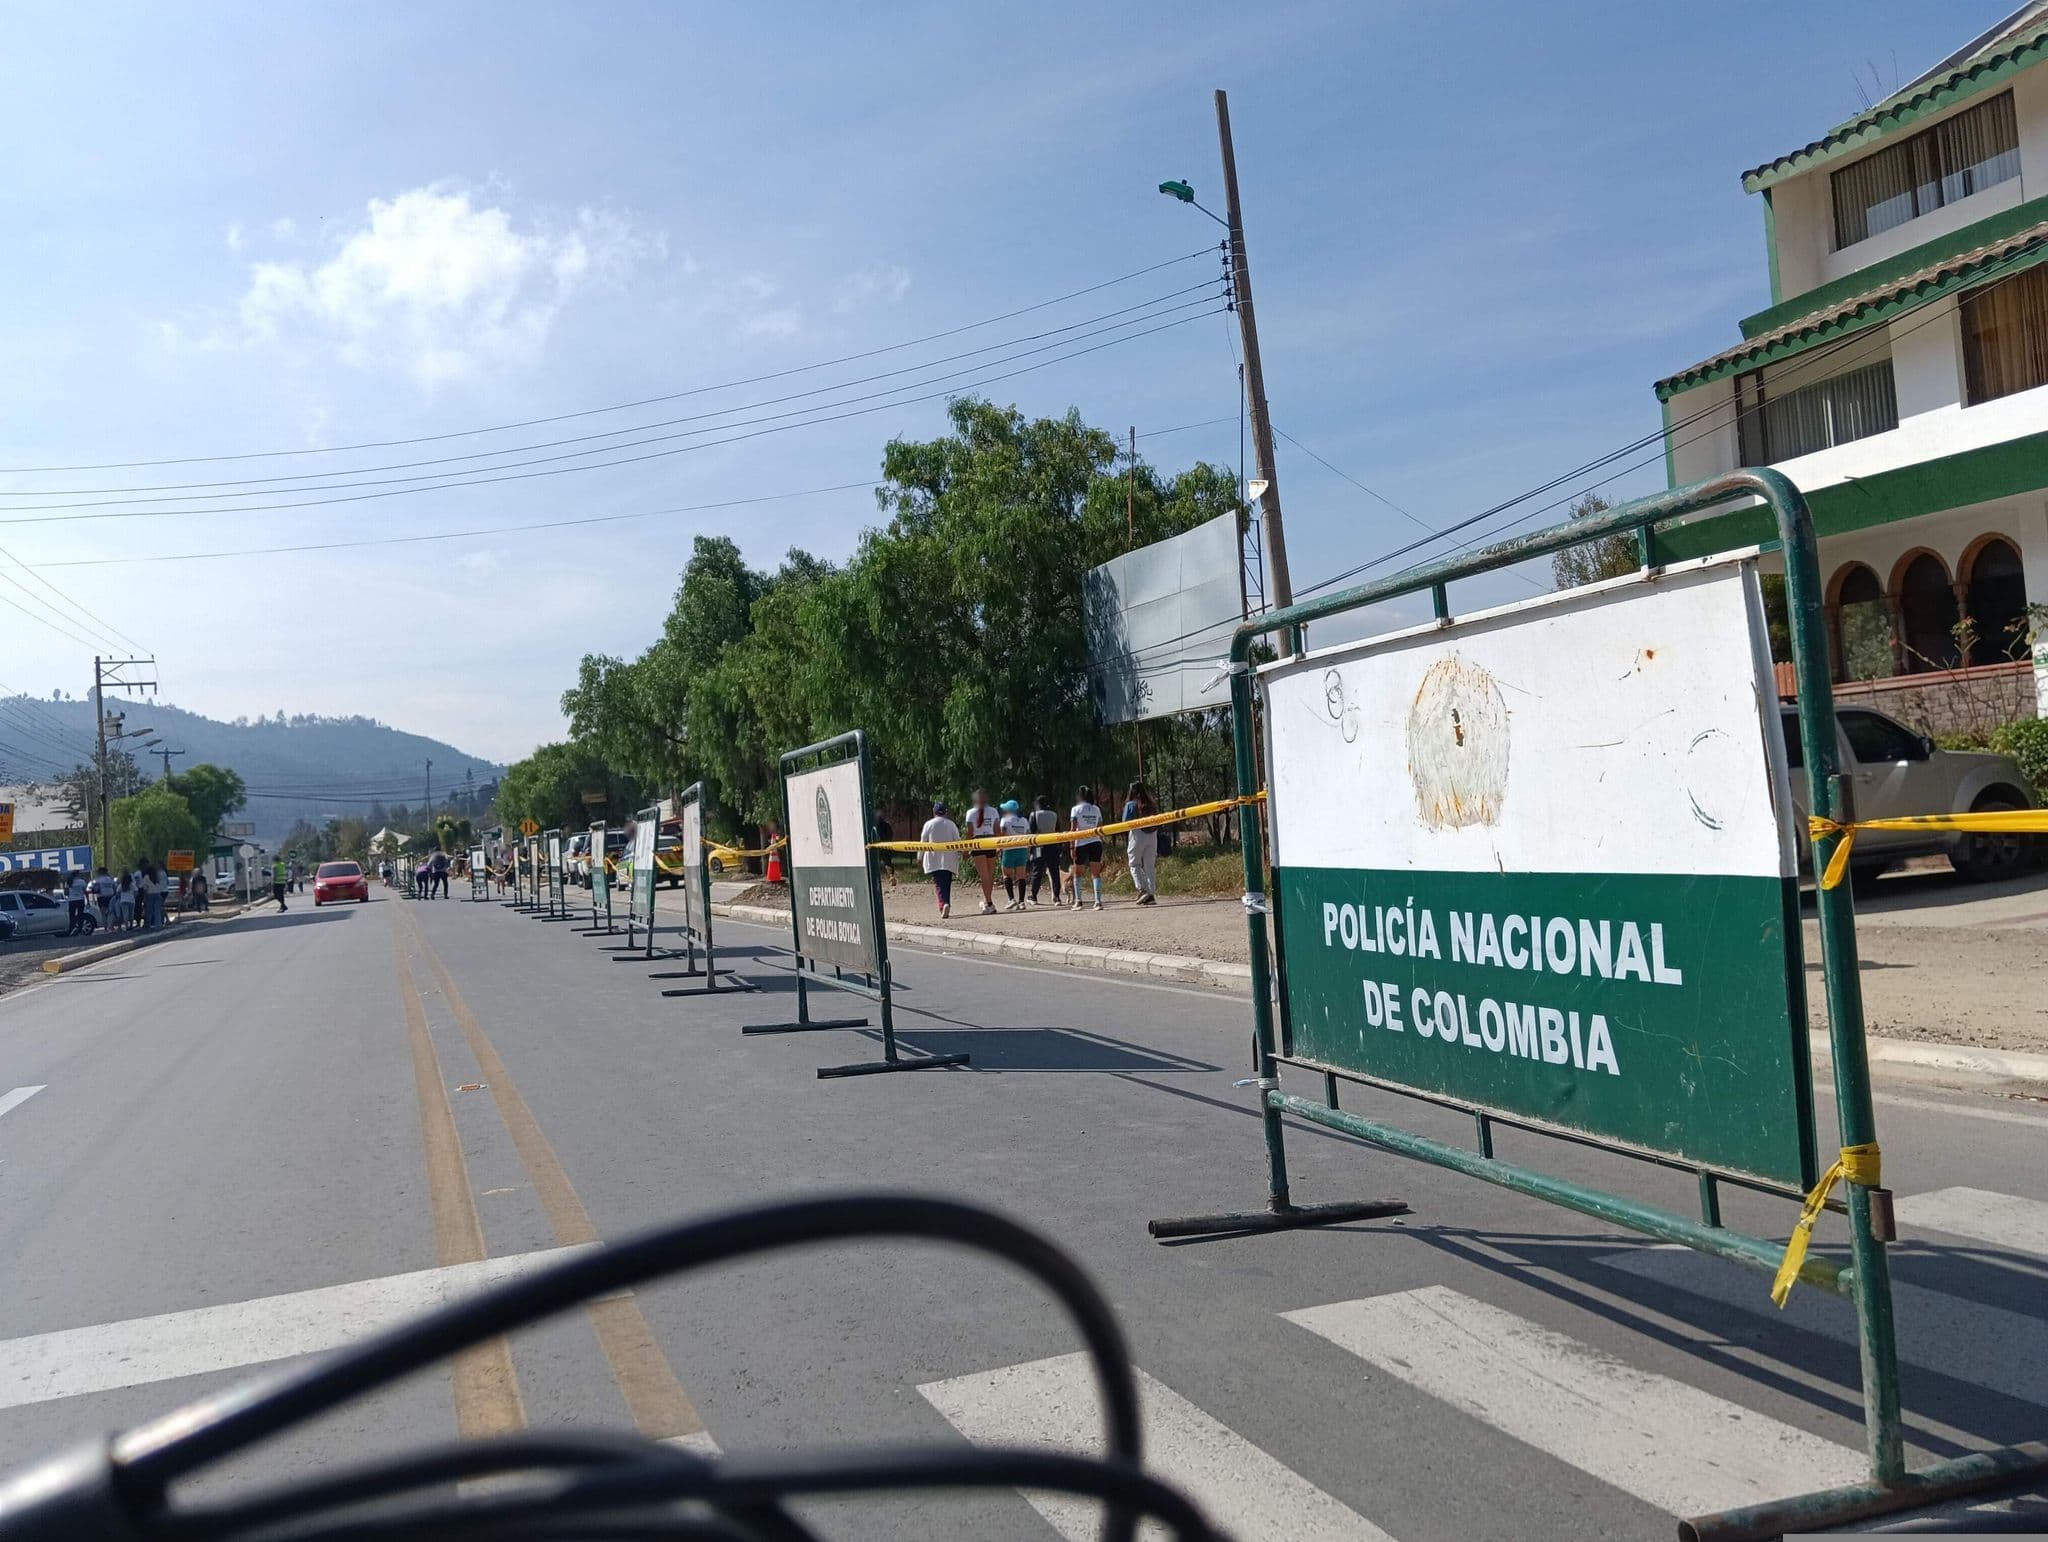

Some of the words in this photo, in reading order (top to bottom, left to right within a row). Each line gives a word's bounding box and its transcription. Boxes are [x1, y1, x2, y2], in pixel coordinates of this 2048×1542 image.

[809, 887, 855, 908] DEPARTAMENTO
[806, 917, 816, 937] DE
[816, 918, 838, 942] POLICIA
[838, 921, 862, 945] BOYACA
[1323, 896, 1441, 960] POLICÍA
[1450, 911, 1683, 986] NACIONAL
[1363, 979, 1404, 1033] DE
[1411, 987, 1621, 1077] COLOMBIA
